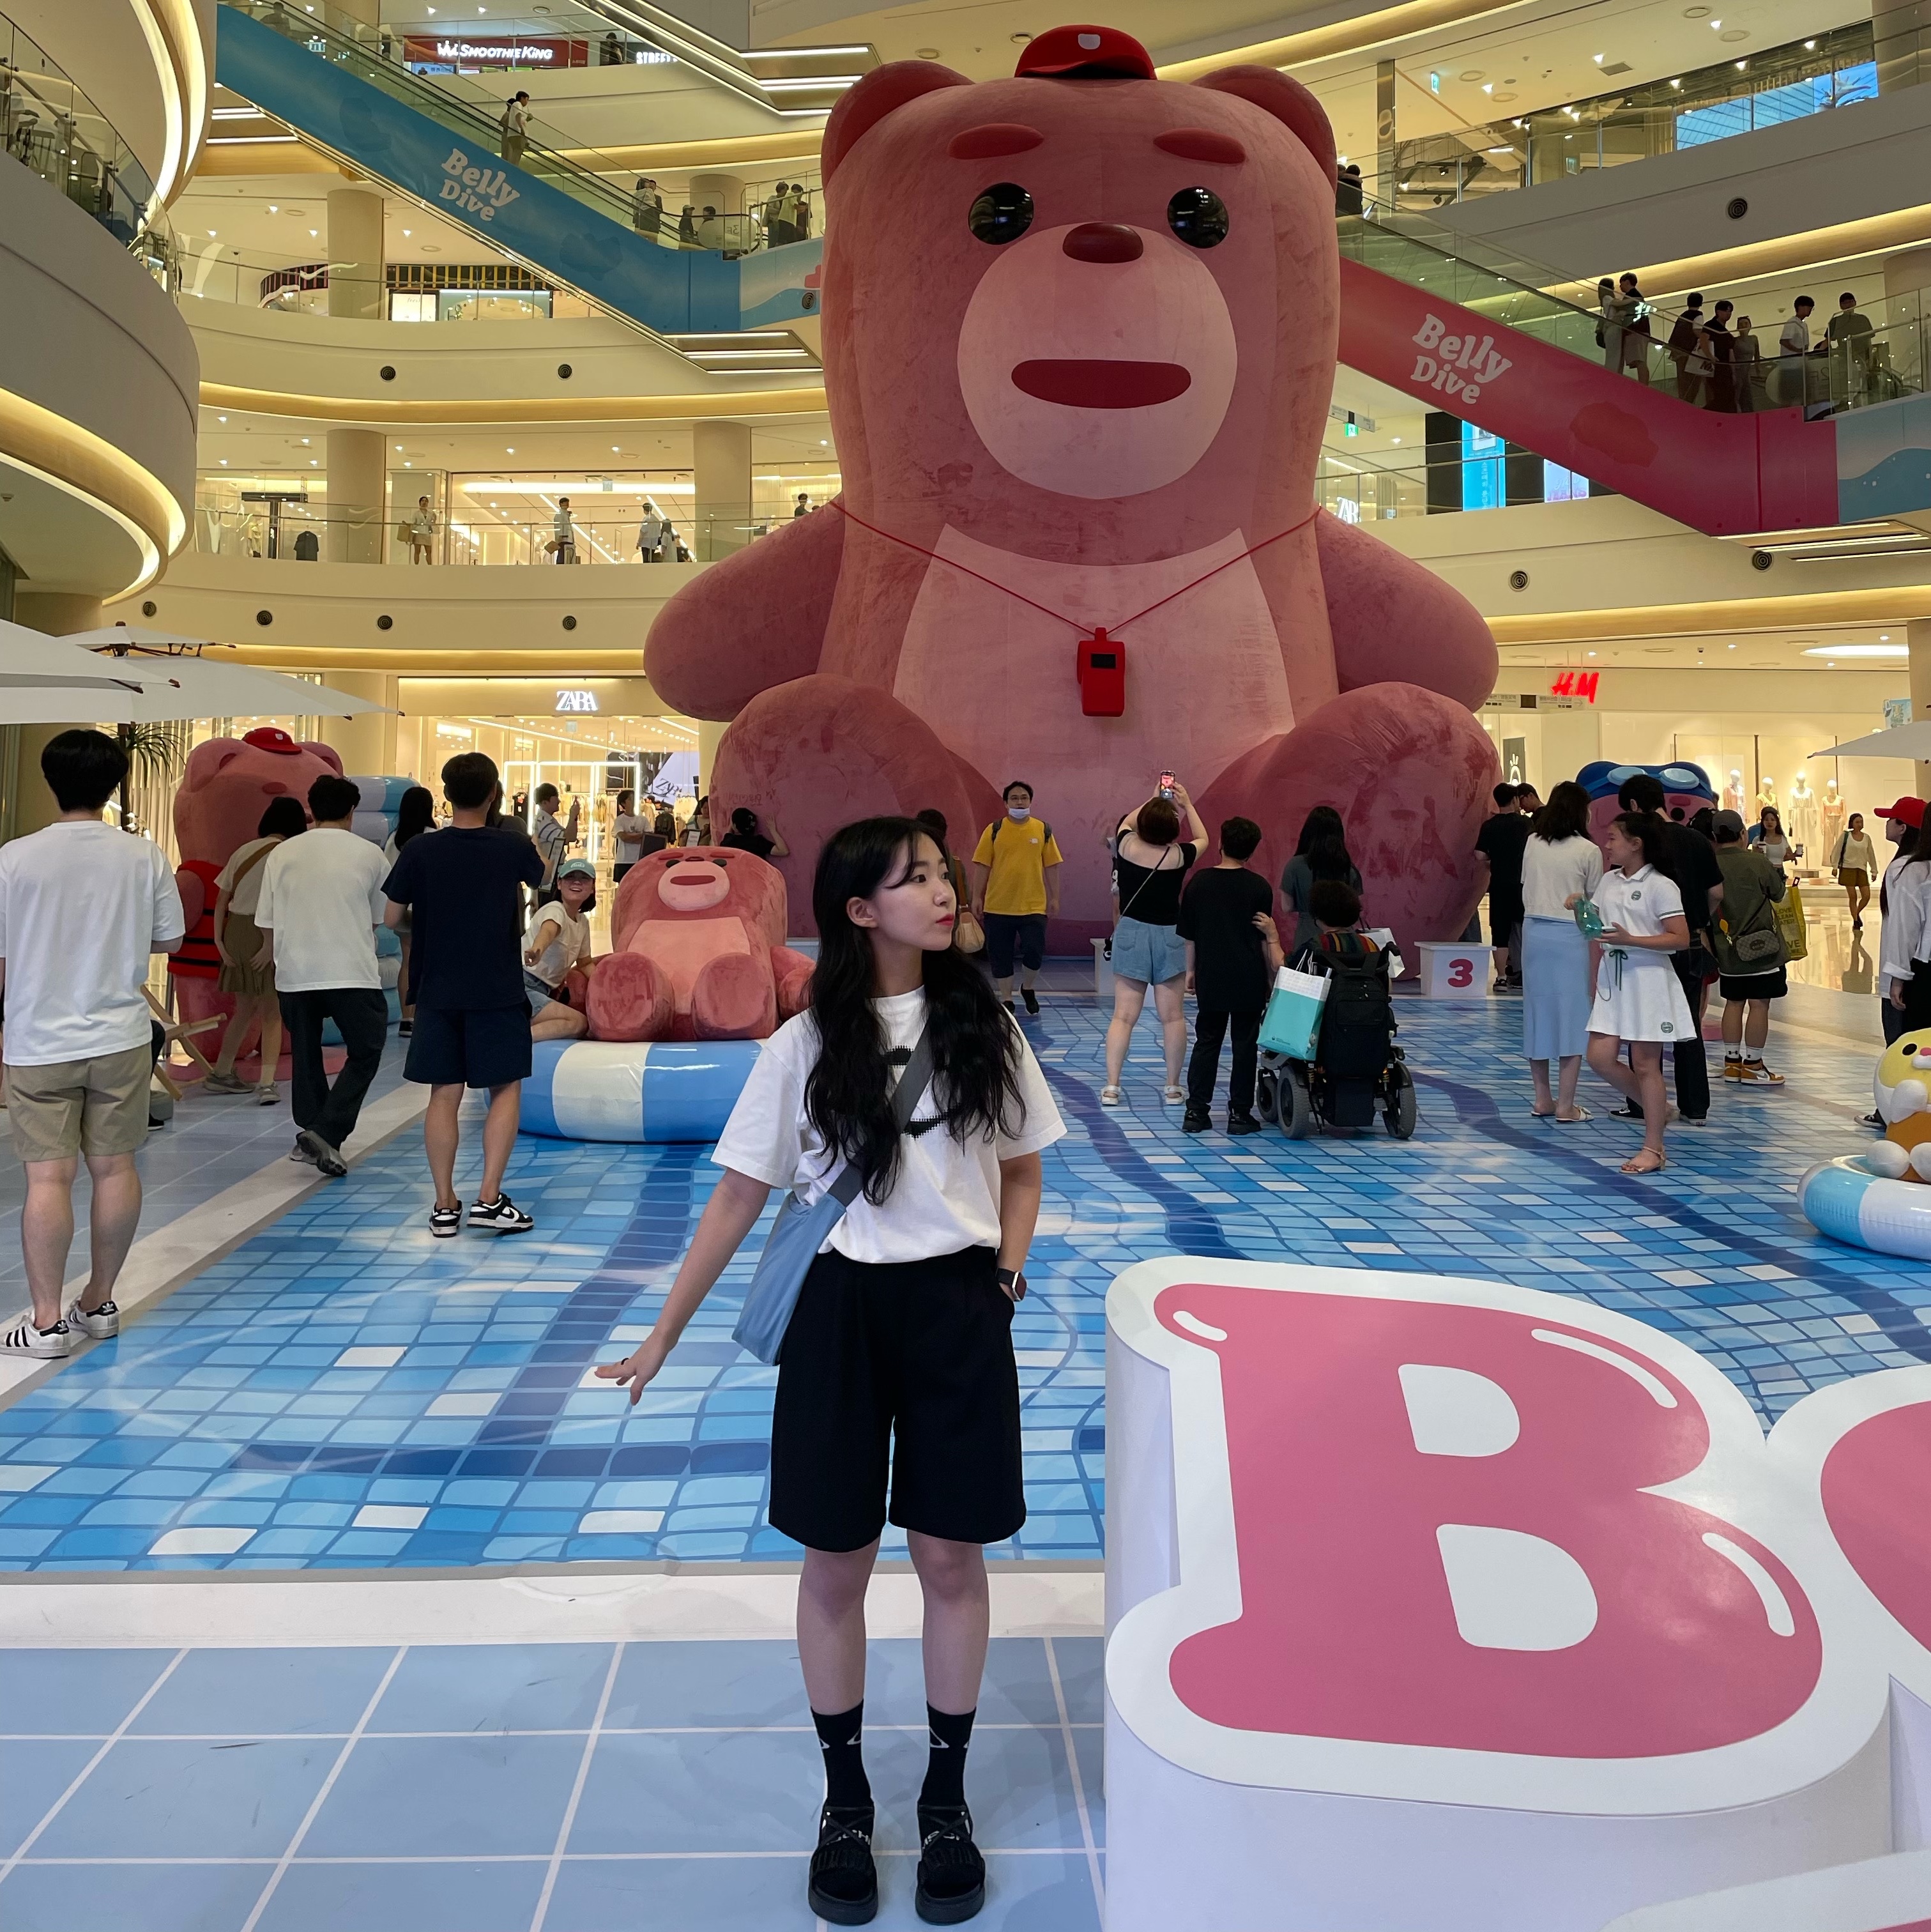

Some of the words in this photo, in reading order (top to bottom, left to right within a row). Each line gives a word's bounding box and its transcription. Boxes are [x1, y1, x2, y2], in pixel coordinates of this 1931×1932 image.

[459, 44, 521, 59] SMOOTHIE
[441, 148, 521, 206] Belly
[439, 179, 495, 221] Dive
[1412, 313, 1513, 383] Belly
[1410, 355, 1480, 404] Dive
[556, 690, 599, 711] ZARA
[1447, 958, 1474, 988] 3
